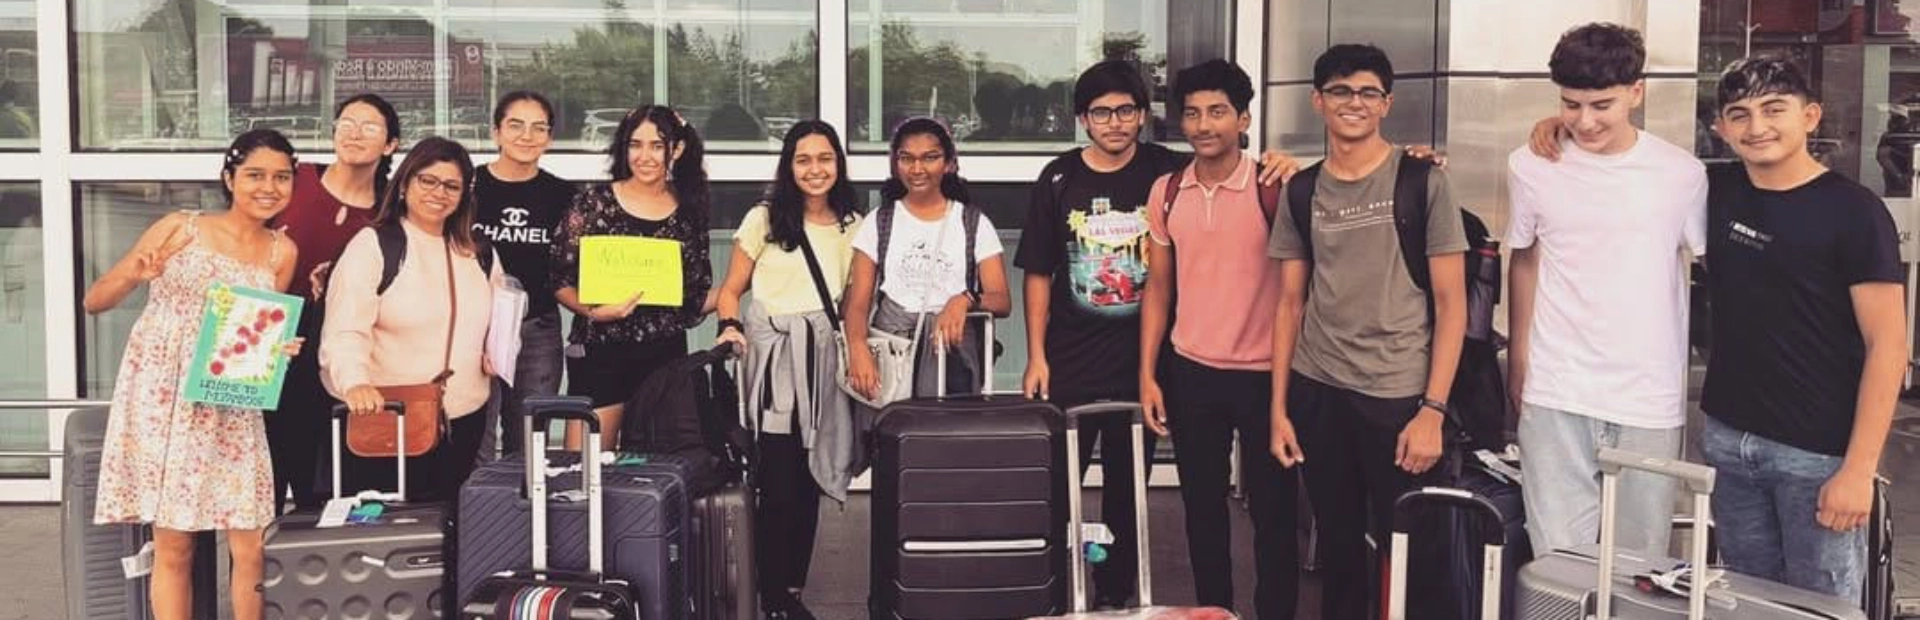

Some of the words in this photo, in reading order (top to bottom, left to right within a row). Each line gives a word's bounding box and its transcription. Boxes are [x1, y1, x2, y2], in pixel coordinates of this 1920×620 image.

[471, 223, 551, 243] CHANEL
[1089, 227, 1106, 236] LAS
[1109, 225, 1140, 235] VEGAS
